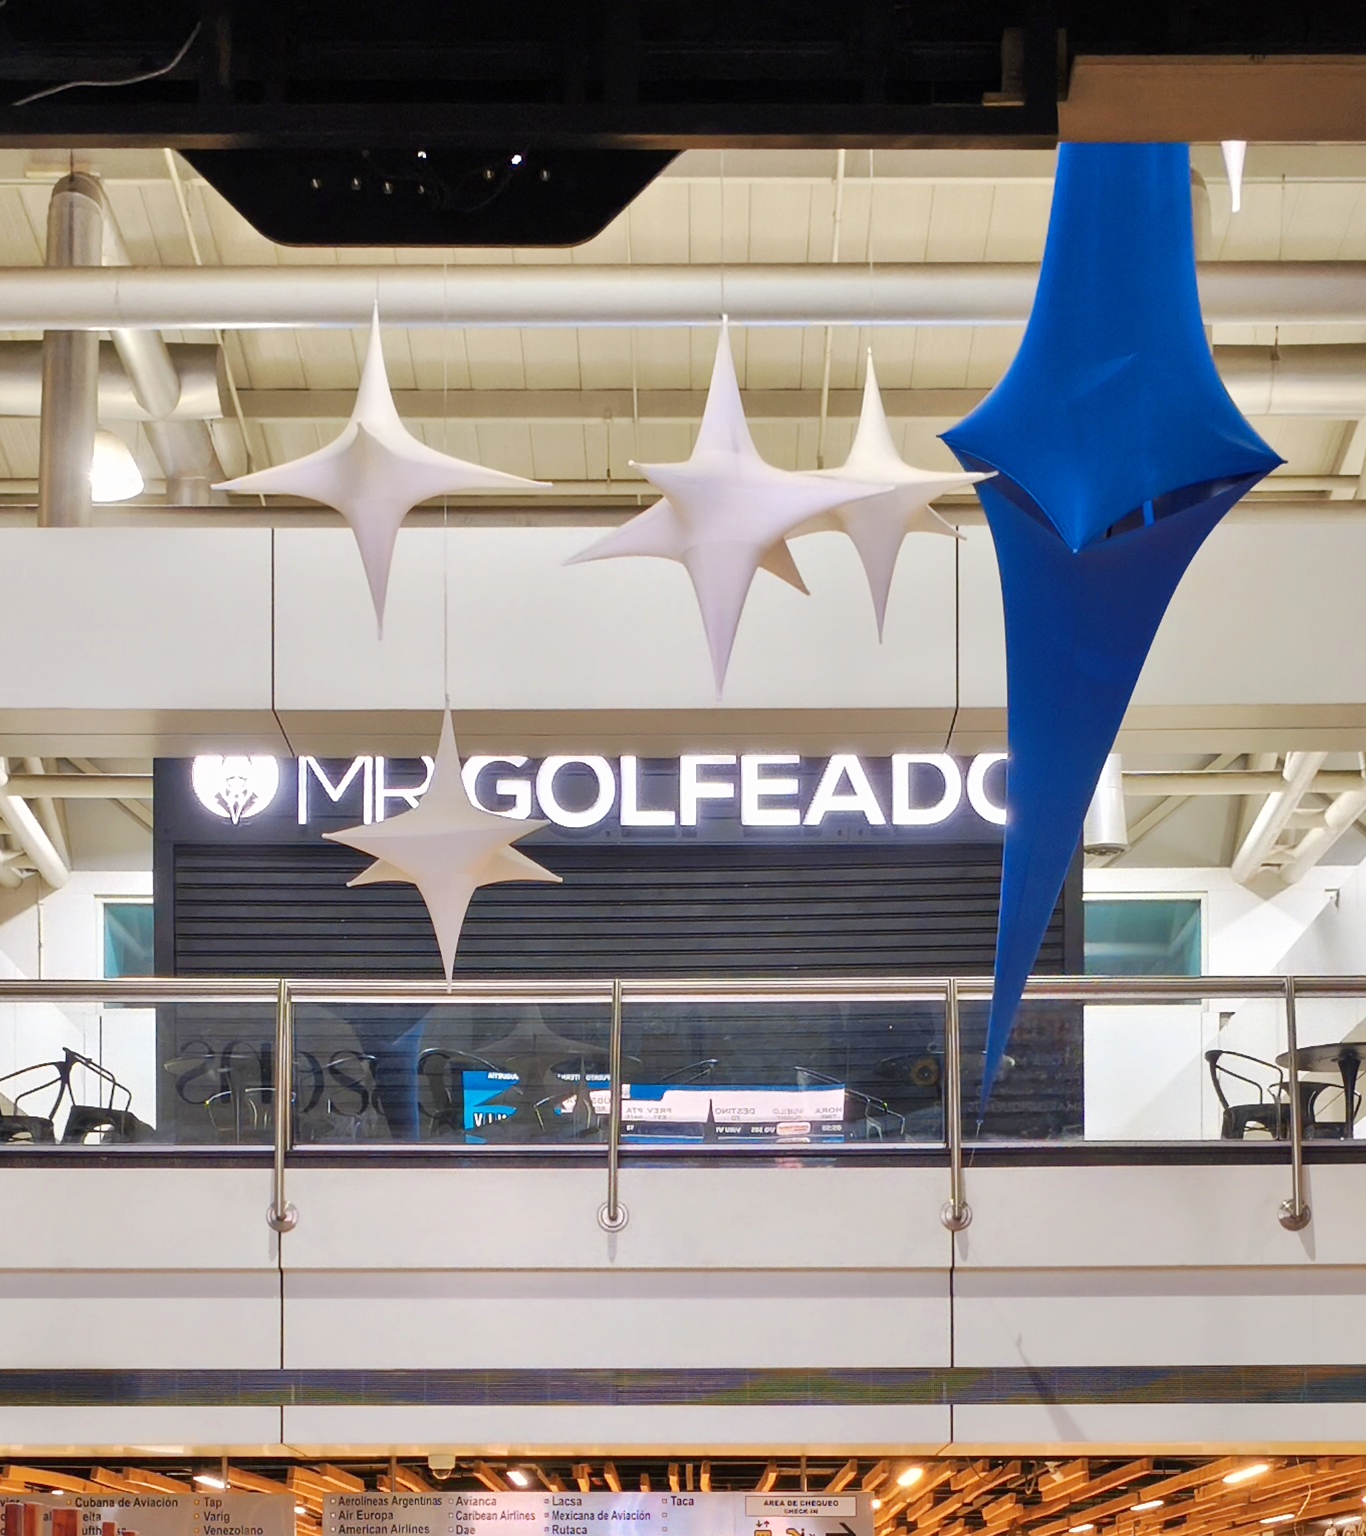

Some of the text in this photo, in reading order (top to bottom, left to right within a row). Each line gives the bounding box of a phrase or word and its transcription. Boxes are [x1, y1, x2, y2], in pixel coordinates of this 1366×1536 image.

[297, 755, 435, 826] MR
[74, 1496, 179, 1508] Cubana de Aviación
[203, 1498, 223, 1510] Tap
[391, 1496, 443, 1509] Argentinas
[455, 1496, 497, 1507] Avianca
[551, 1496, 583, 1507] Lacsa
[670, 1496, 695, 1507] Taca
[203, 1511, 231, 1524] Varig
[338, 1510, 394, 1523] Air Europa
[455, 1510, 536, 1521] Caribean Airlines
[551, 1510, 651, 1521] Mexicana de Aviación
[203, 1525, 264, 1536] Venezolano
[338, 1524, 430, 1535] American Airlines
[455, 1525, 476, 1535] Dae
[551, 1525, 588, 1535] Rutaca
